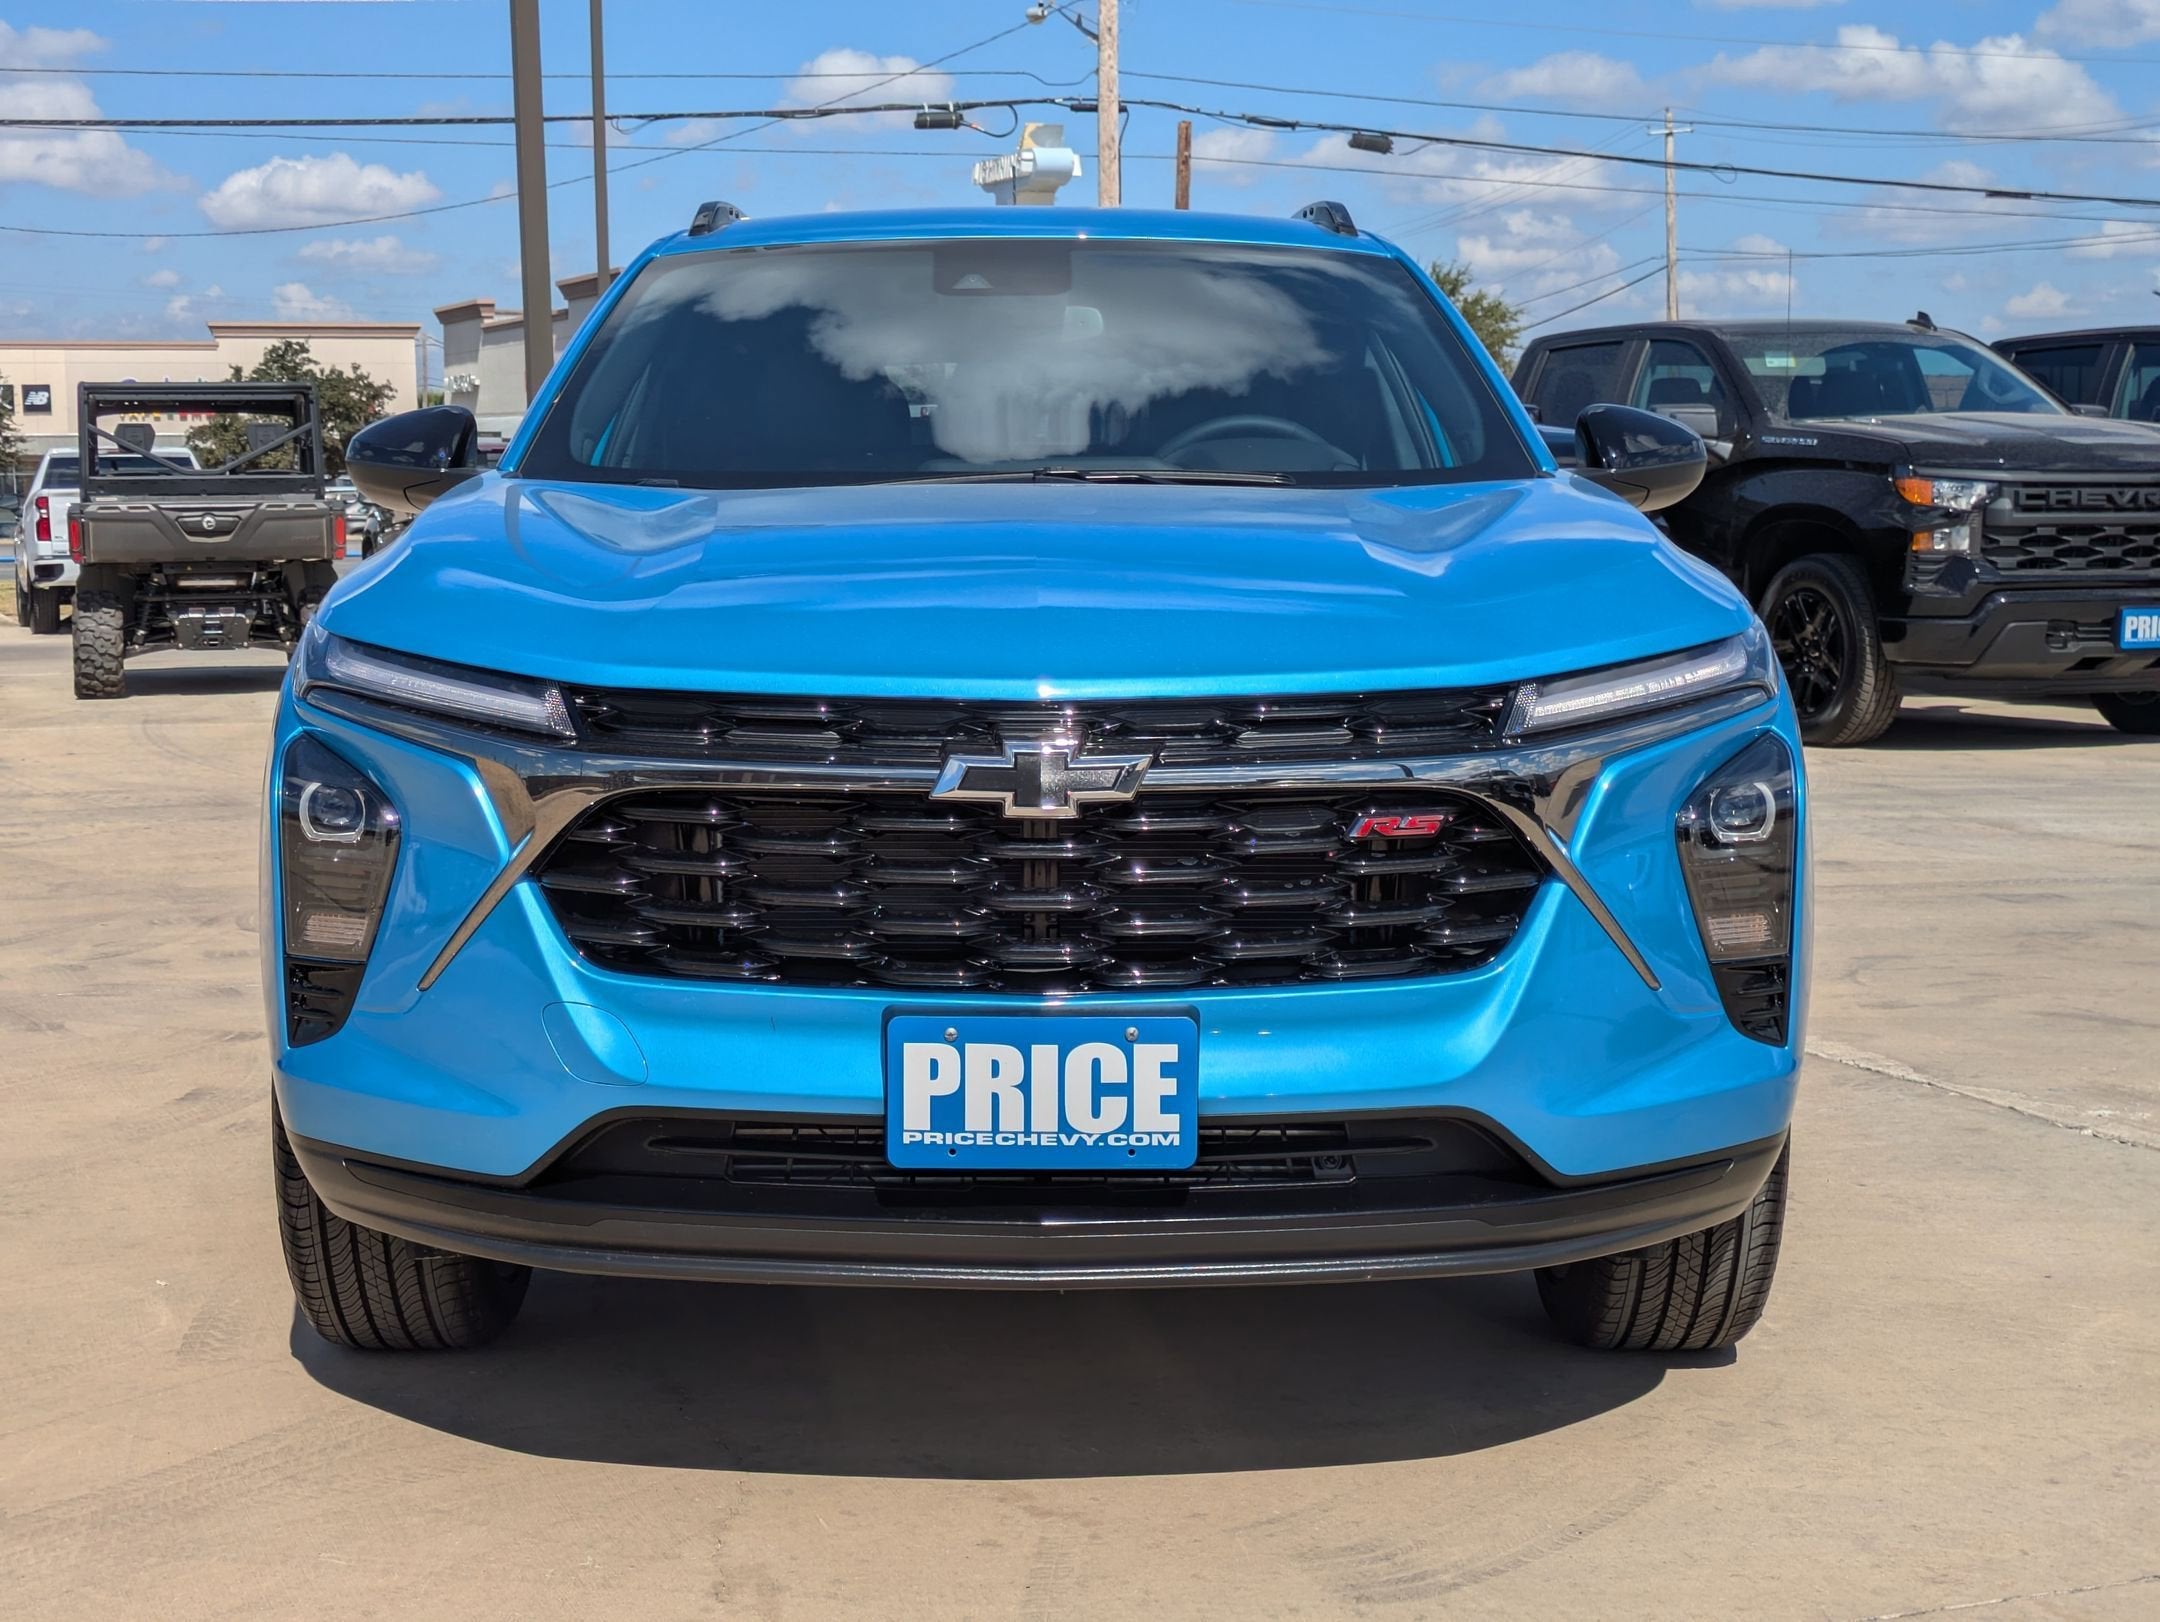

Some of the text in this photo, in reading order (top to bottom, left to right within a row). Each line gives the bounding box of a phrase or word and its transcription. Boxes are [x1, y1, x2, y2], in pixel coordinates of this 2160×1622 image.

[2125, 615, 2160, 640] PRI
[1348, 814, 1444, 838] RS
[903, 1042, 1180, 1133] PRICE
[903, 1132, 1180, 1146] PRICECHEVY.COM
